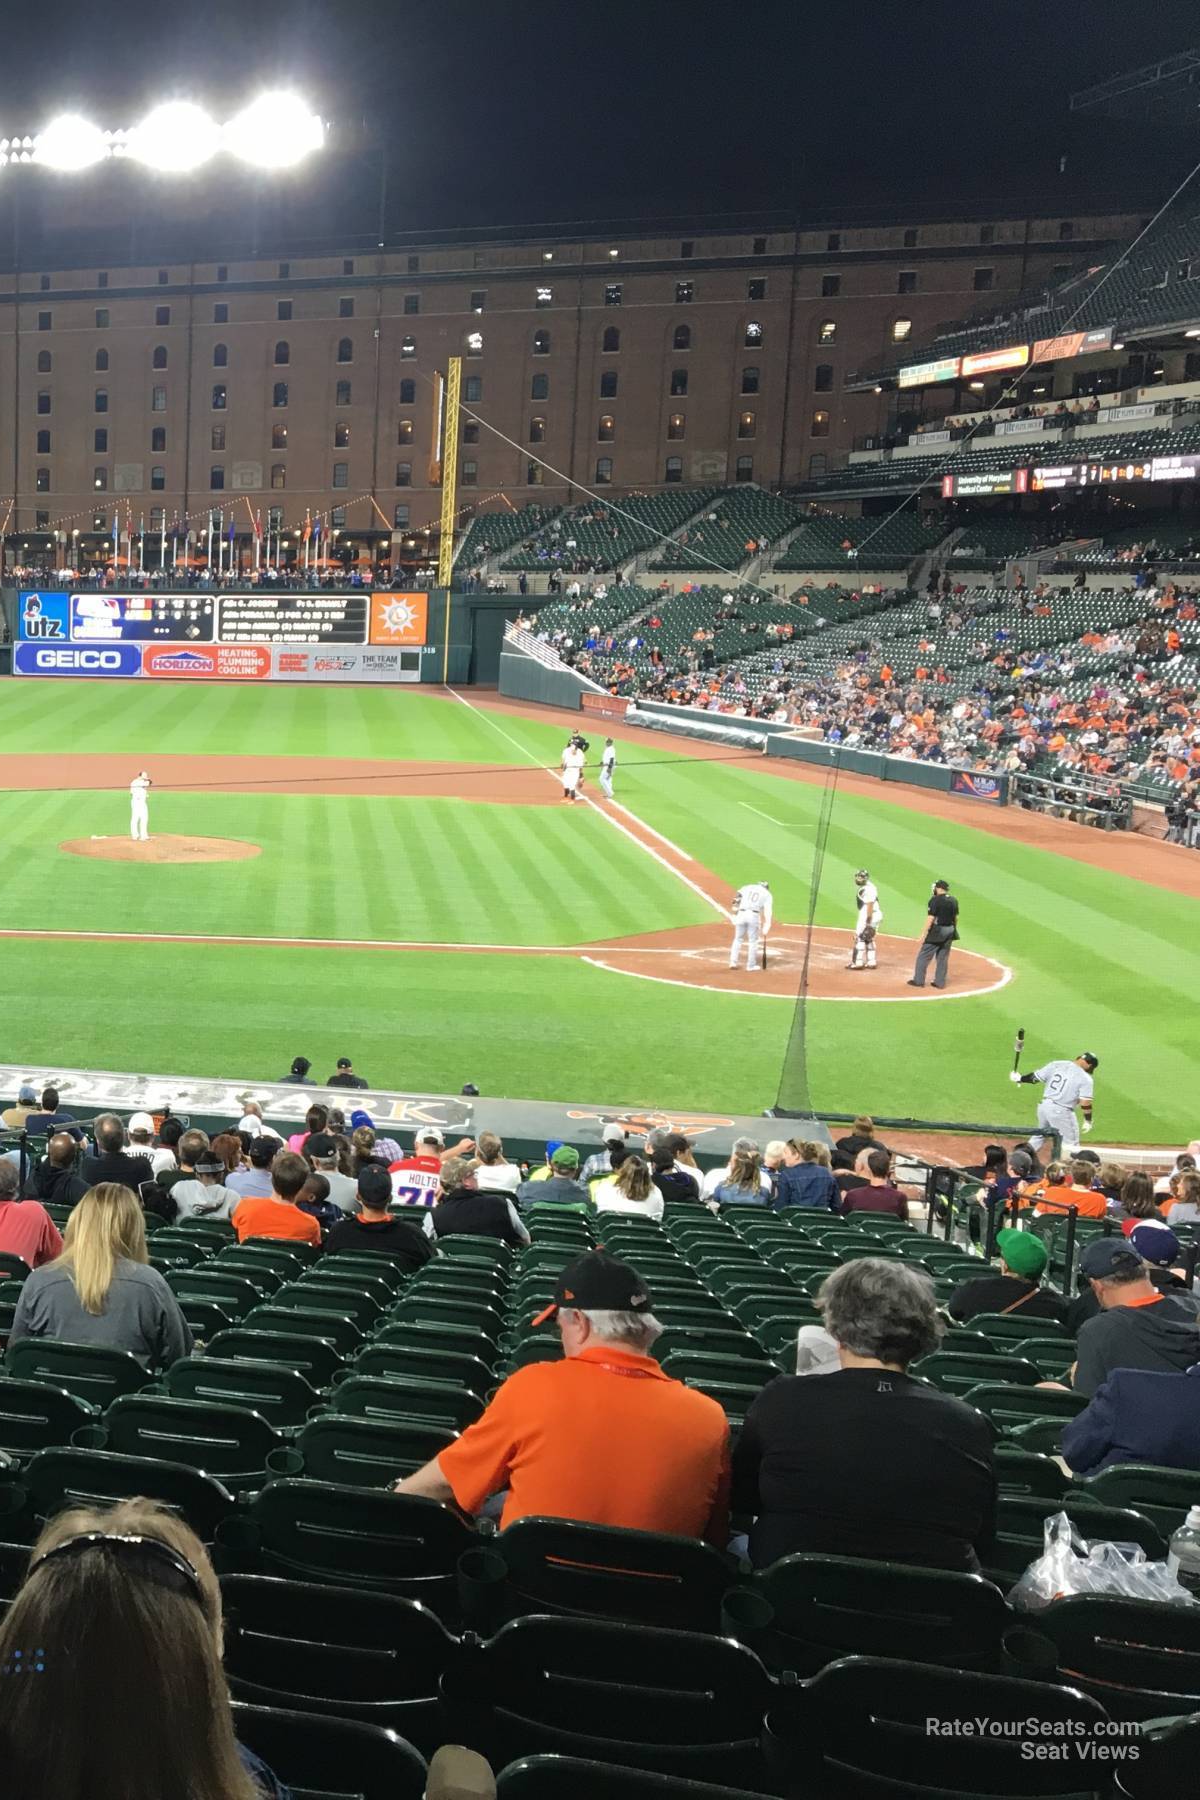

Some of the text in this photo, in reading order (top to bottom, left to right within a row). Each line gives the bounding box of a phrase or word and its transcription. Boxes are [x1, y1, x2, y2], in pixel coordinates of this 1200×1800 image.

[958, 475, 984, 485] University
[989, 472, 1011, 483] Maryland
[958, 484, 975, 494] Medical
[976, 483, 993, 493] Center
[218, 649, 257, 657] HEATING
[37, 650, 121, 669] GEICO
[218, 658, 264, 666] PLUMBING
[362, 655, 376, 663] THE
[377, 655, 398, 665] TEAM
[153, 660, 212, 670] HORIZON
[218, 666, 257, 674] COOLING
[1050, 1074, 1067, 1092] 21
